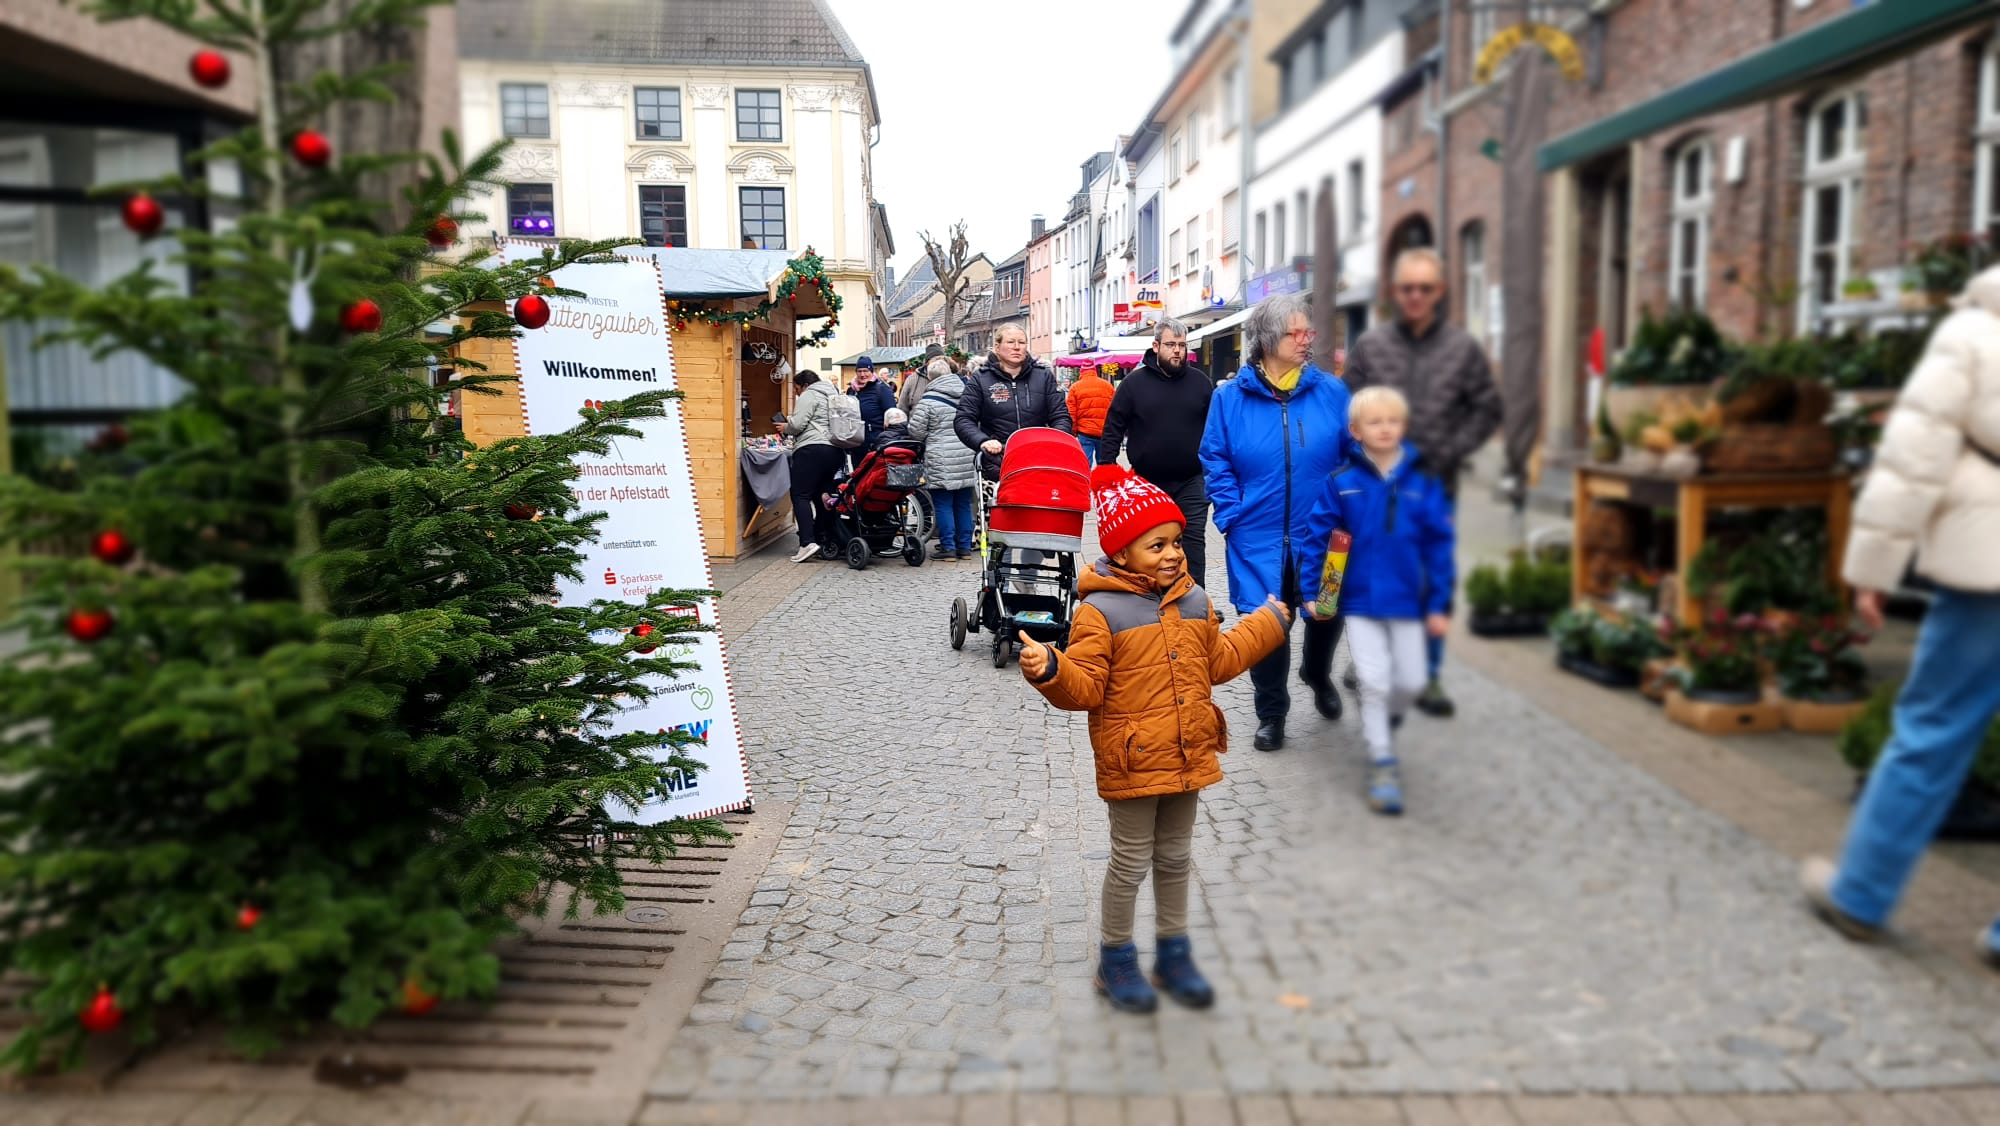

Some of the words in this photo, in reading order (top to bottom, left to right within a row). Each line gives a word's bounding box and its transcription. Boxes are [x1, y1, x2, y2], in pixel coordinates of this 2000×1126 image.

[1137, 287, 1159, 301] dm
[544, 304, 659, 339] üttenzauber
[543, 360, 657, 382] Willkommen!
[582, 462, 668, 476] ihnachtsmarkt
[587, 486, 607, 501] der
[610, 485, 670, 503] Apfelstadt
[603, 539, 642, 550] unterstützt
[642, 540, 658, 548] von:
[620, 573, 664, 585] Sparkasse
[622, 585, 653, 597] Krefeld
